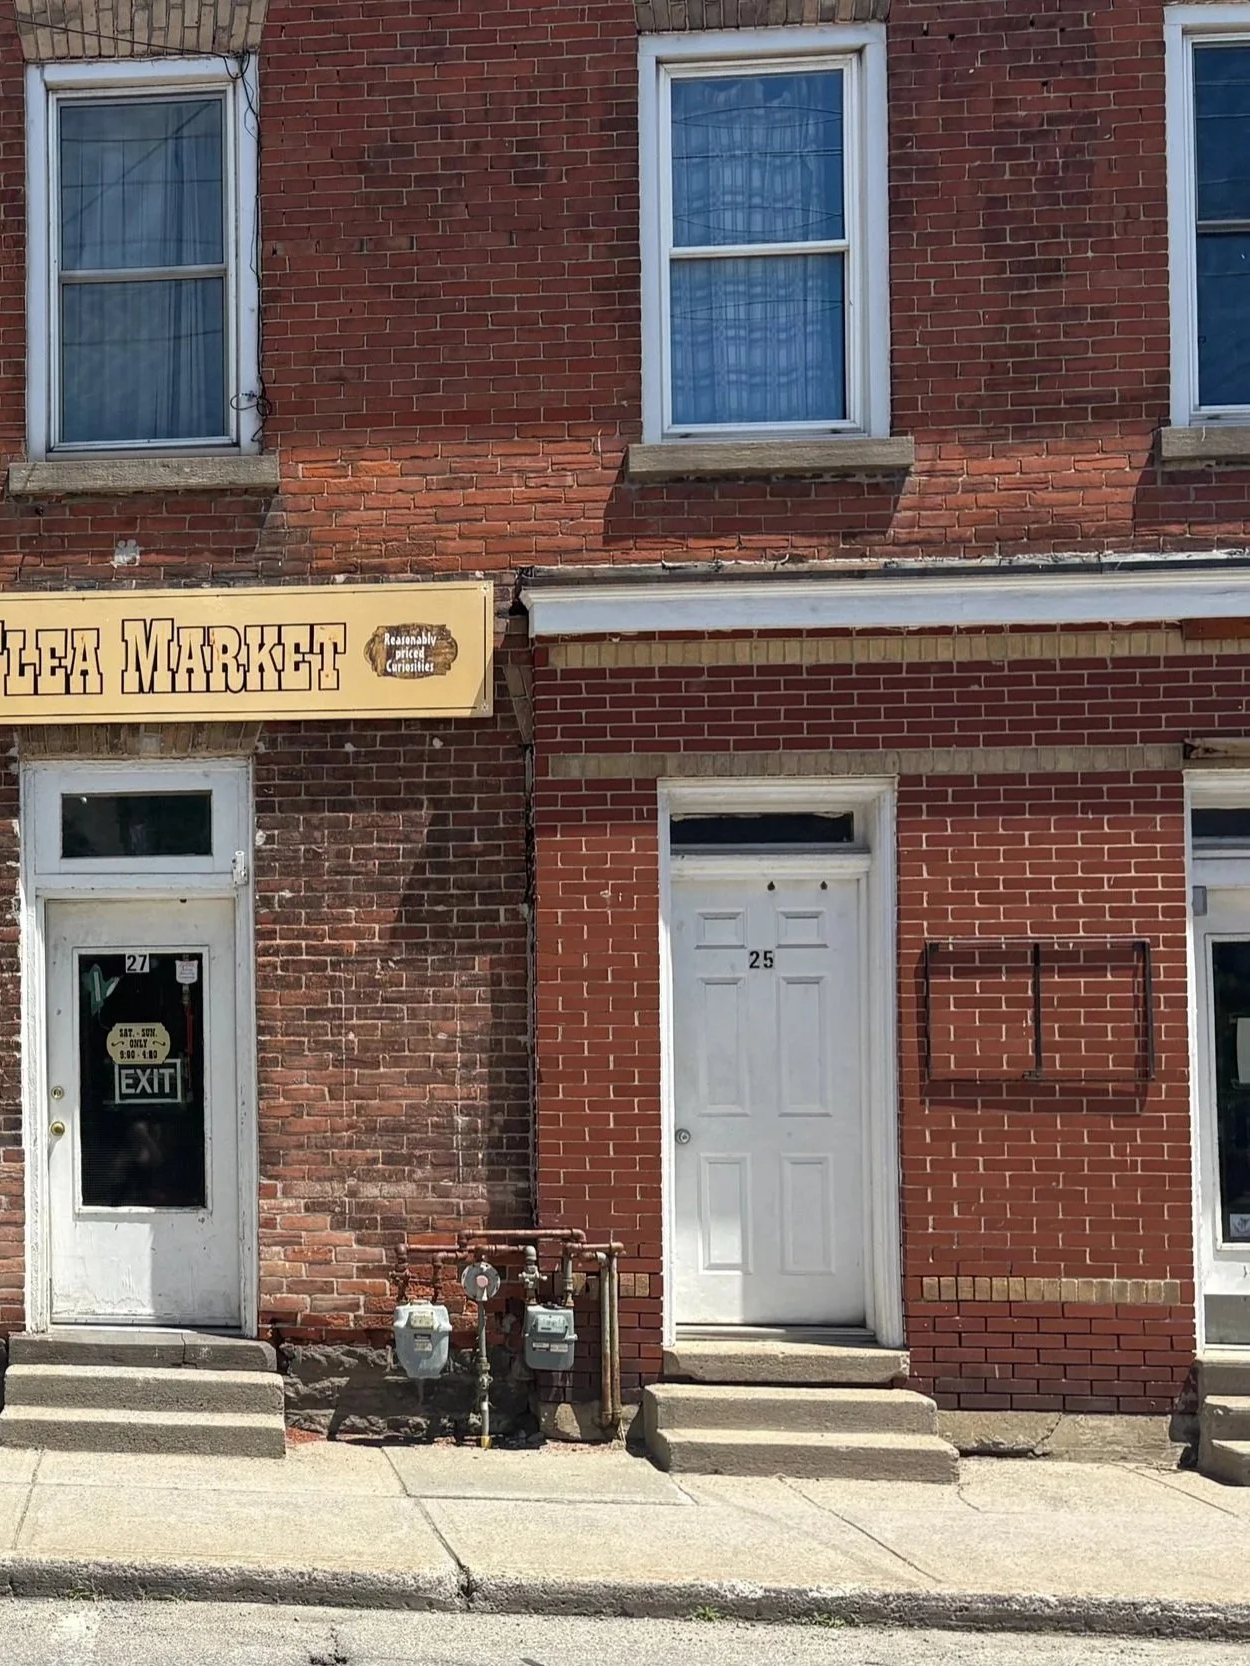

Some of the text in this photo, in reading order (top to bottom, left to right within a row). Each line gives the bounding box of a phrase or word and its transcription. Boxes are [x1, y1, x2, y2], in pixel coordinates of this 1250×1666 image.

[384, 632, 436, 646] Reasonably
[121, 617, 347, 695] MARKET
[395, 646, 425, 660] priced
[386, 660, 434, 672] Curiosities
[127, 954, 148, 971] 27
[749, 950, 774, 969] 25
[119, 1028, 135, 1037] SAT.
[141, 1028, 158, 1037] SUN.
[129, 1039, 148, 1048] ONLY
[120, 1068, 175, 1094] EXIT
